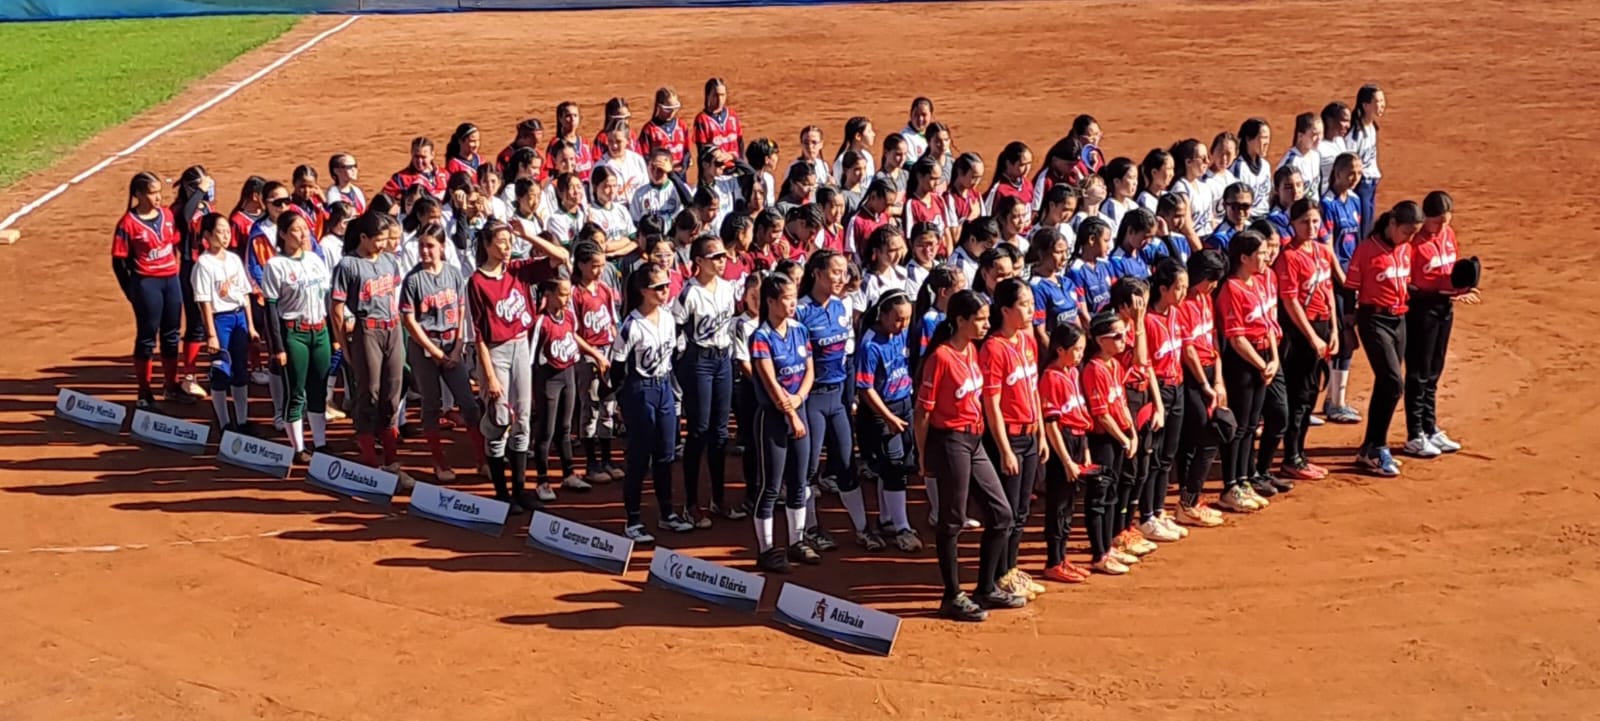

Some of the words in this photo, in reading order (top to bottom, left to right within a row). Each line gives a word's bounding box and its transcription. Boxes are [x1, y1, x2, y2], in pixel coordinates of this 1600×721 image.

[685, 565, 719, 585] Central
[720, 577, 747, 595] Glória
[830, 607, 865, 629] Atibaia
